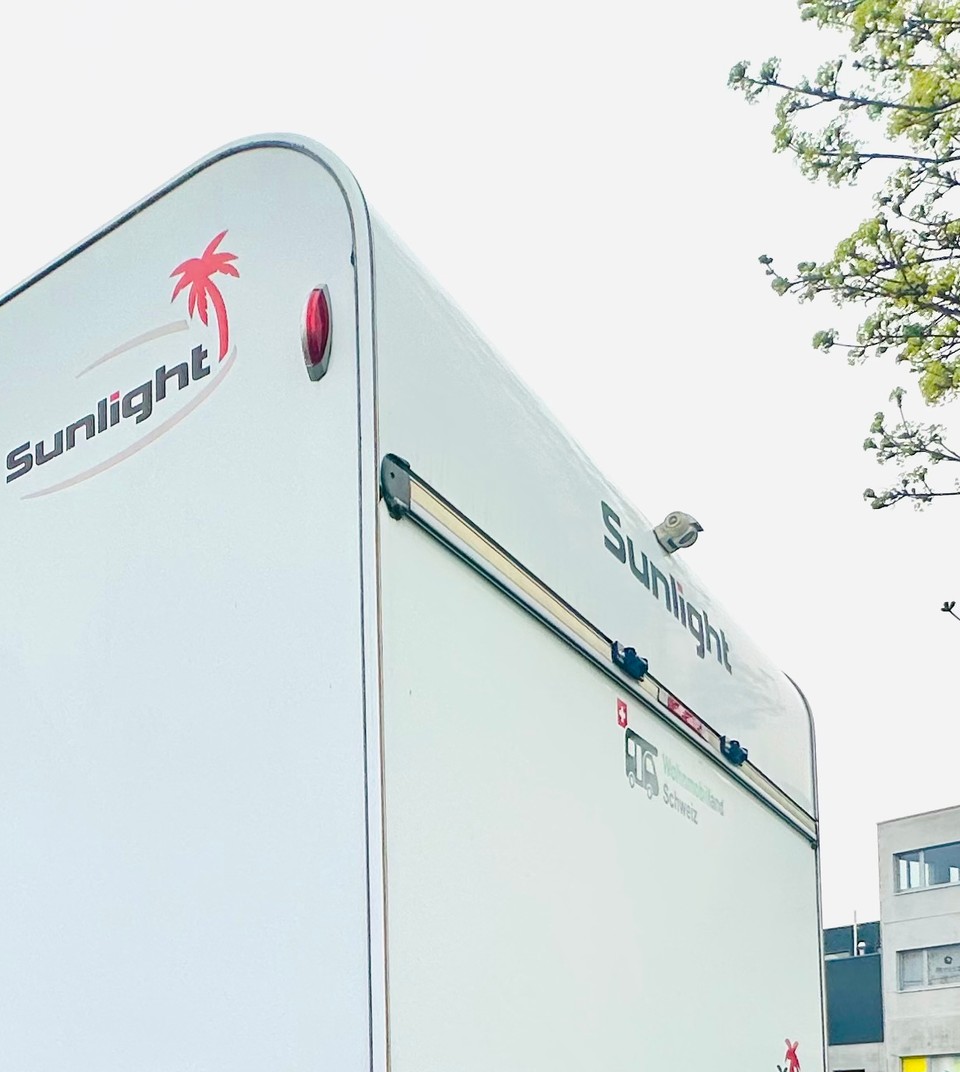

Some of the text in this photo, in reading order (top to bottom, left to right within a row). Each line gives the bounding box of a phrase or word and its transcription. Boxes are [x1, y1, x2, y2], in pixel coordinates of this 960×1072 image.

[6, 344, 211, 484] Sunlight
[601, 500, 732, 675] Sunlight
[662, 783, 698, 824] Schweiz
